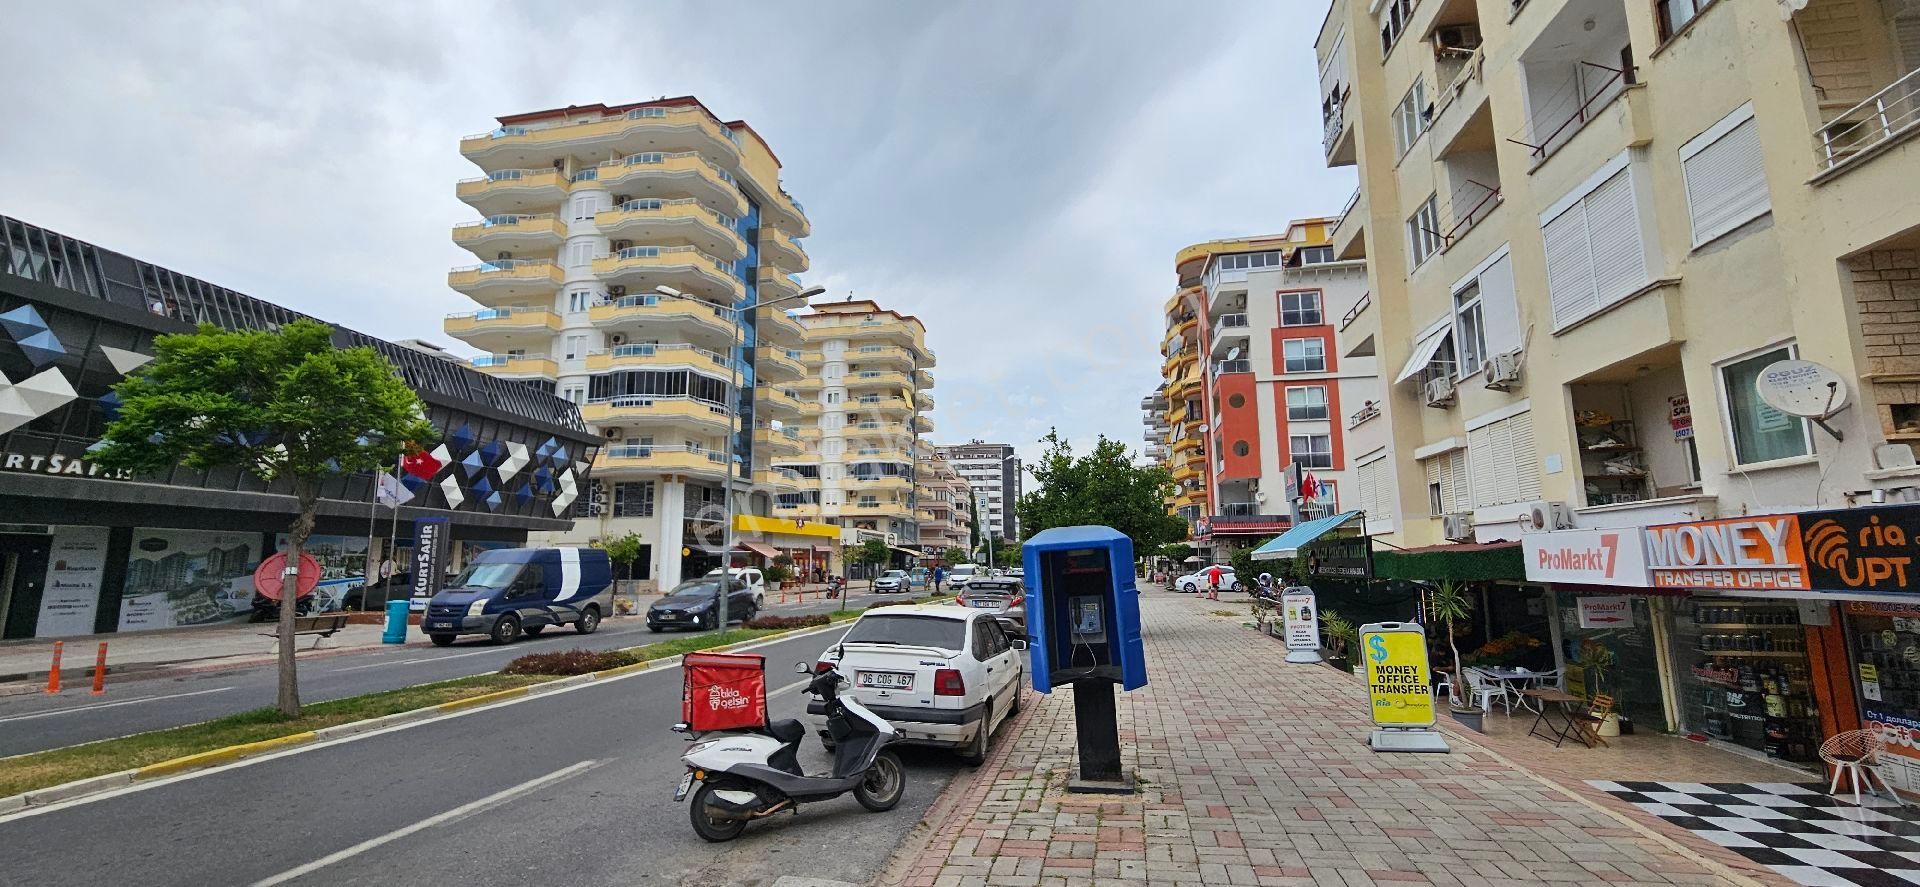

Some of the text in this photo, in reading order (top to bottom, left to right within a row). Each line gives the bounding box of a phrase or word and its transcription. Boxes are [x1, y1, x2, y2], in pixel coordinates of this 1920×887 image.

[1859, 514, 1906, 547] ria
[1645, 518, 1793, 567] MONEY
[1655, 571, 1734, 587] TRANSFER
[1737, 571, 1802, 588] OFFICE
[1838, 556, 1912, 588] UPT
[1376, 666, 1418, 674] MONEY
[863, 673, 873, 683] 06
[896, 675, 912, 686] 467
[1378, 675, 1420, 684] OFFICE
[1371, 685, 1429, 694] TRANSFER
